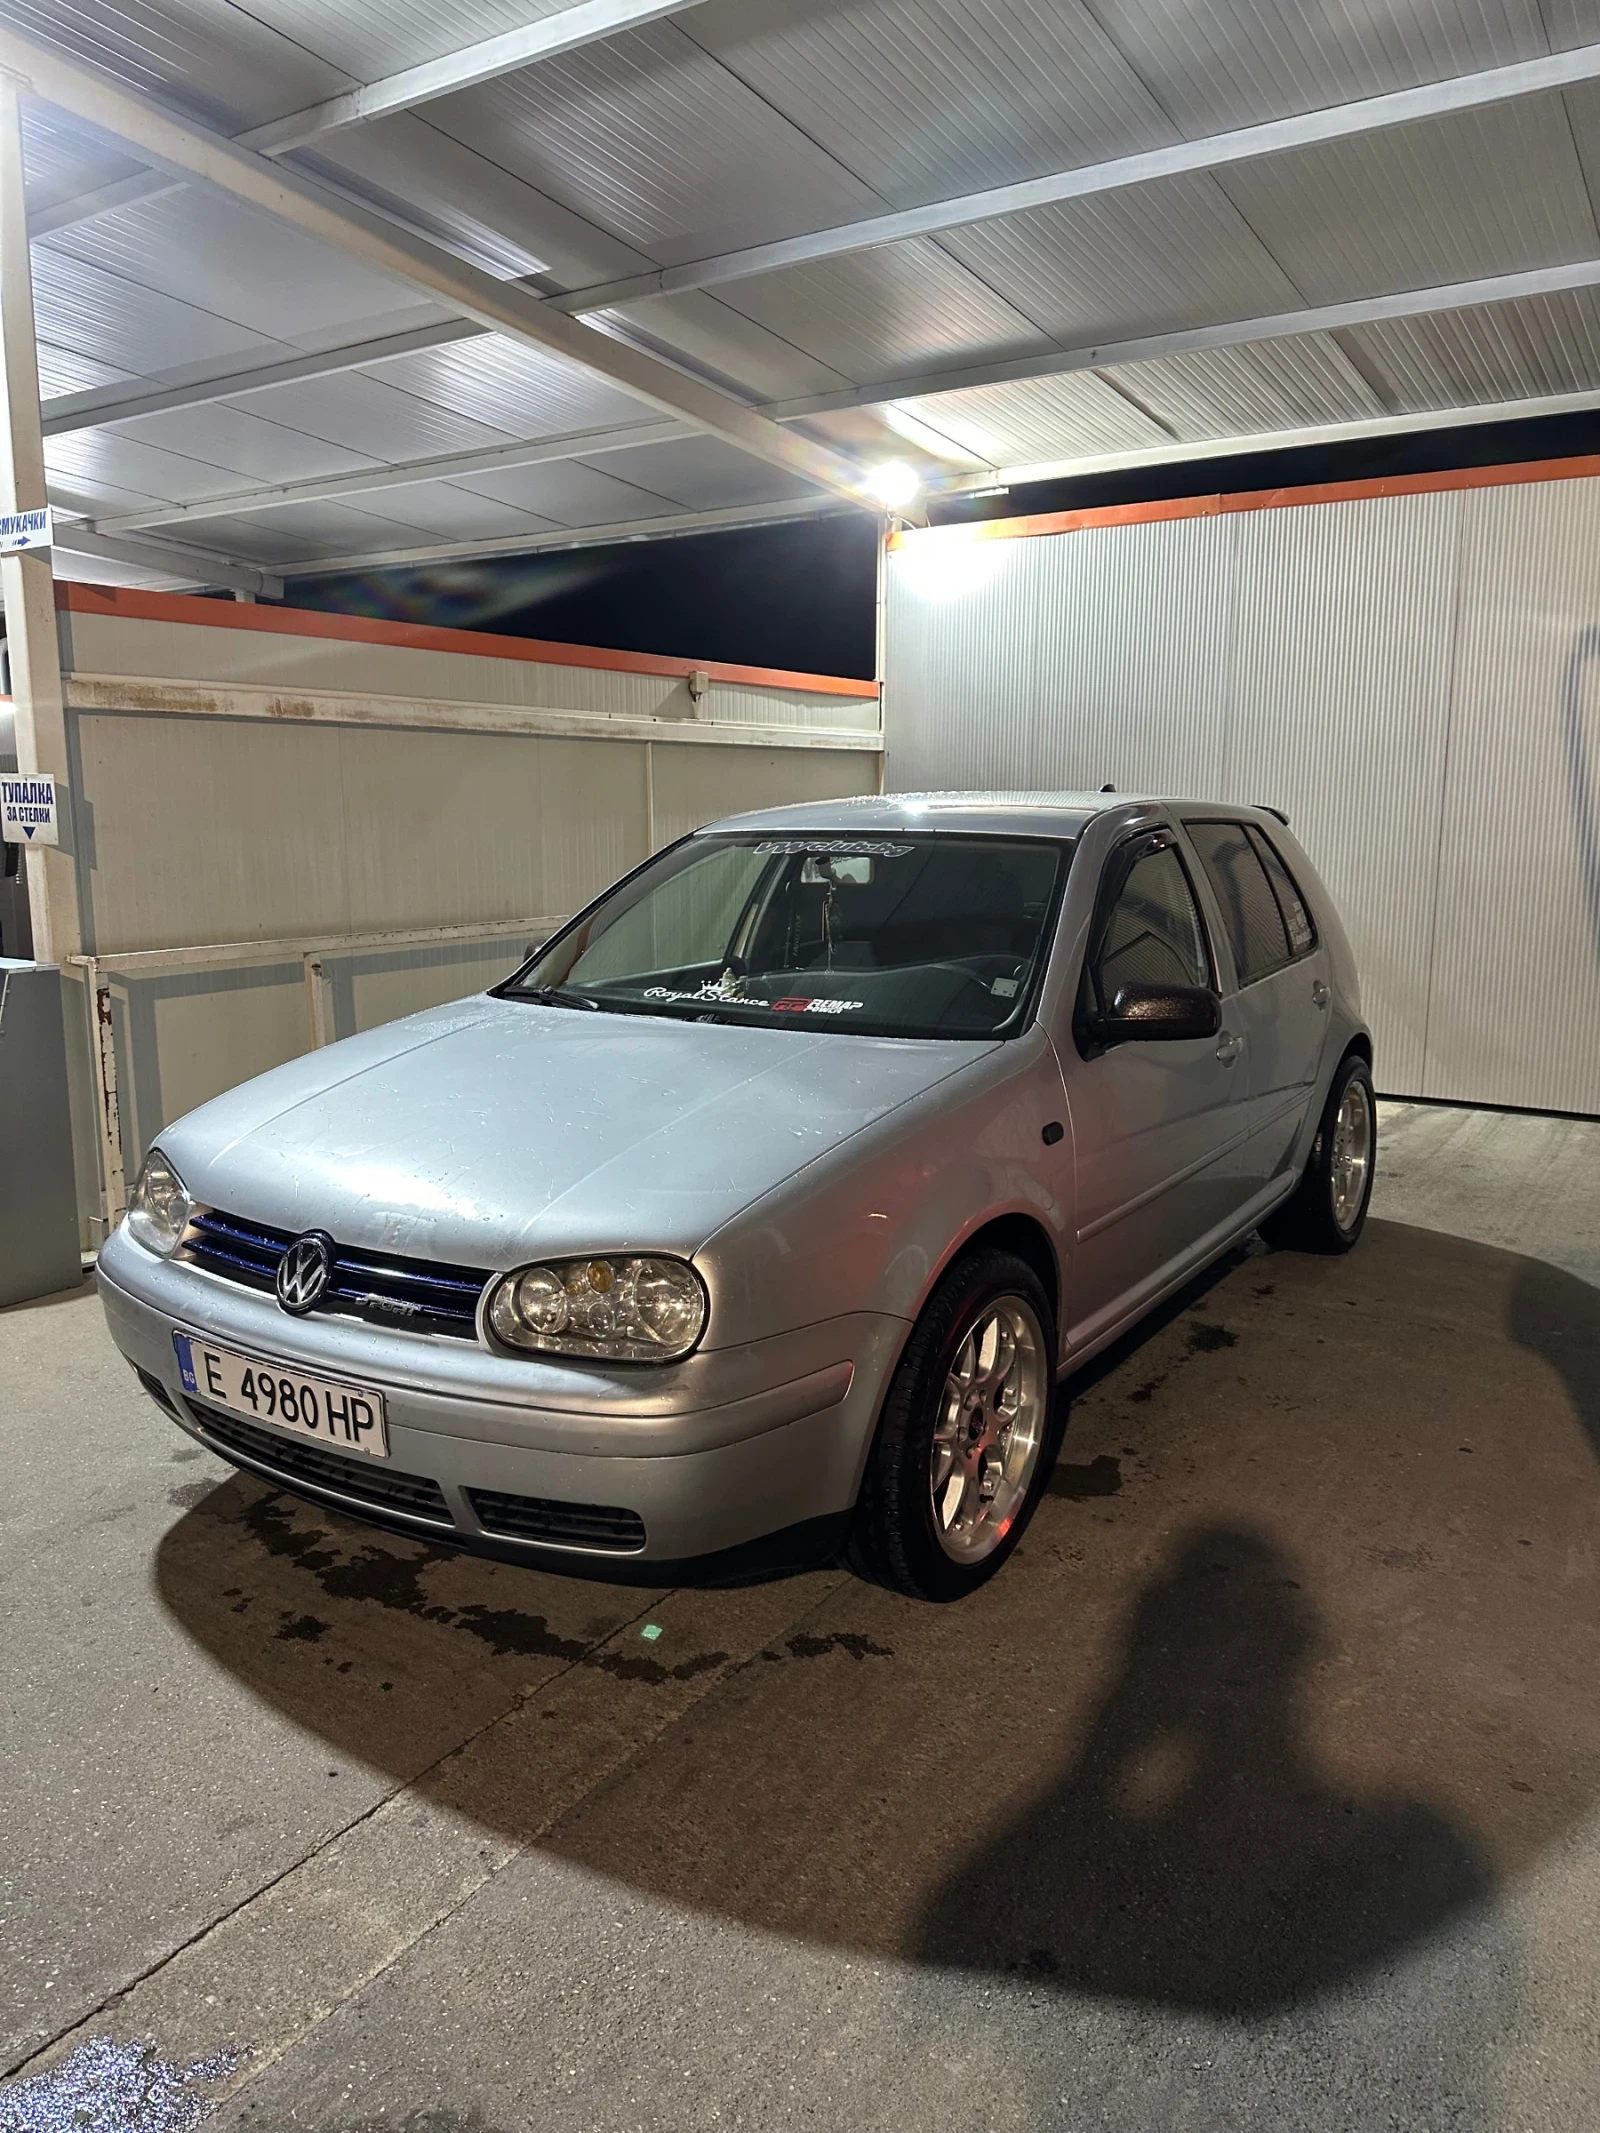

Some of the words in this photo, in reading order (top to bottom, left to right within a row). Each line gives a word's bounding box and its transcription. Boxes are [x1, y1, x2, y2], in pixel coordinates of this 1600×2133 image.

[0, 511, 47, 535] МУКАЧКИ
[2, 782, 53, 804] ТУПАЛКА
[7, 806, 17, 821] ЗА
[19, 807, 50, 823] СТЕЛКИ
[808, 998, 864, 1010] REMAP
[183, 1369, 195, 1384] BG
[204, 1352, 227, 1399] E
[241, 1367, 319, 1429] 4980
[325, 1390, 374, 1443] HP
